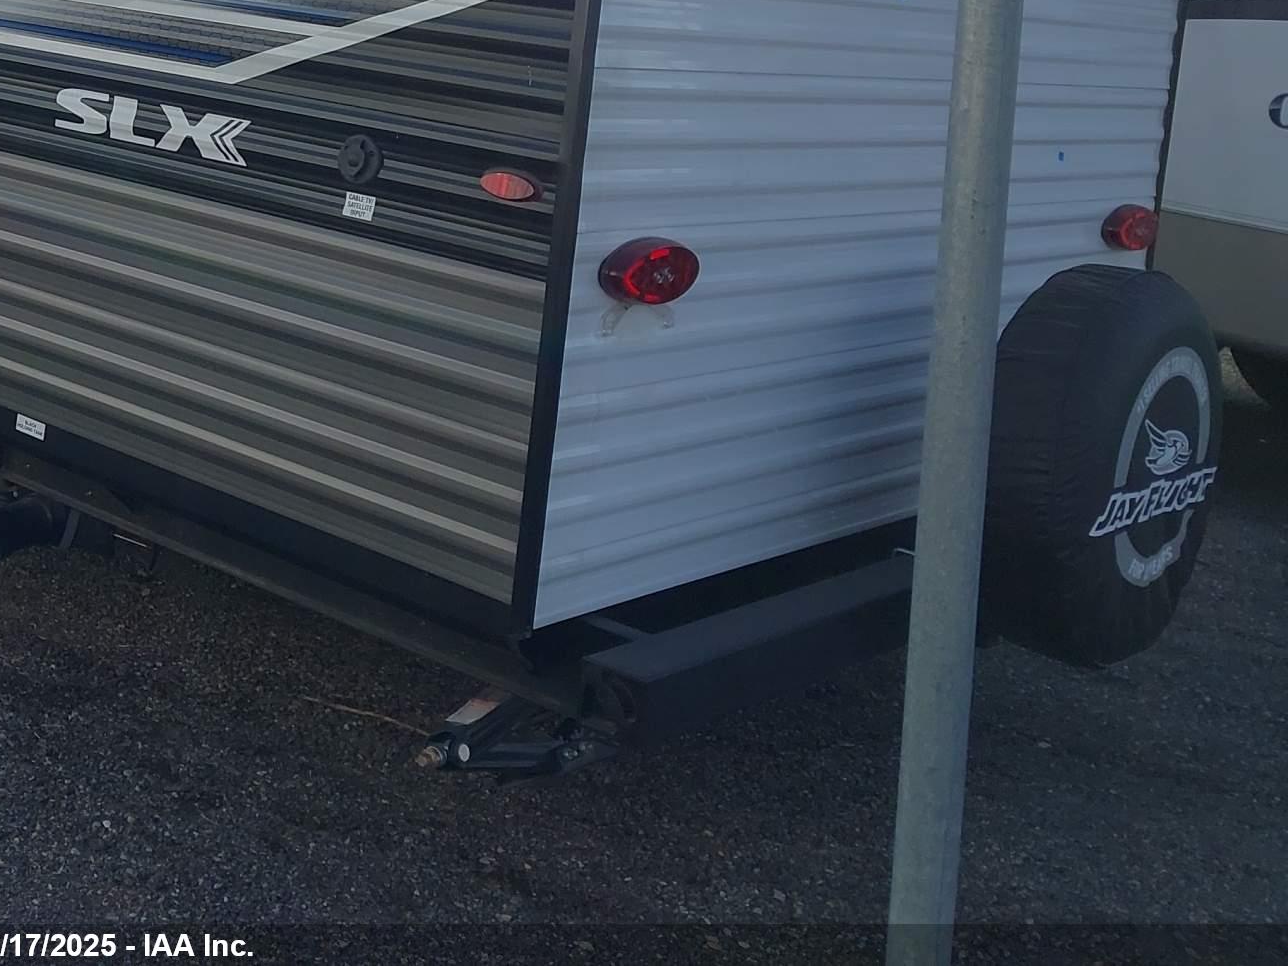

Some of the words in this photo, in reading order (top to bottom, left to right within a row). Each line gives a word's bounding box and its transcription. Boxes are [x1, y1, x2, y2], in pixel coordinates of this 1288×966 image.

[54, 88, 251, 167] SLX
[349, 194, 364, 203] CABLE
[347, 201, 374, 212] SATELLITE
[350, 209, 366, 217] INPUT
